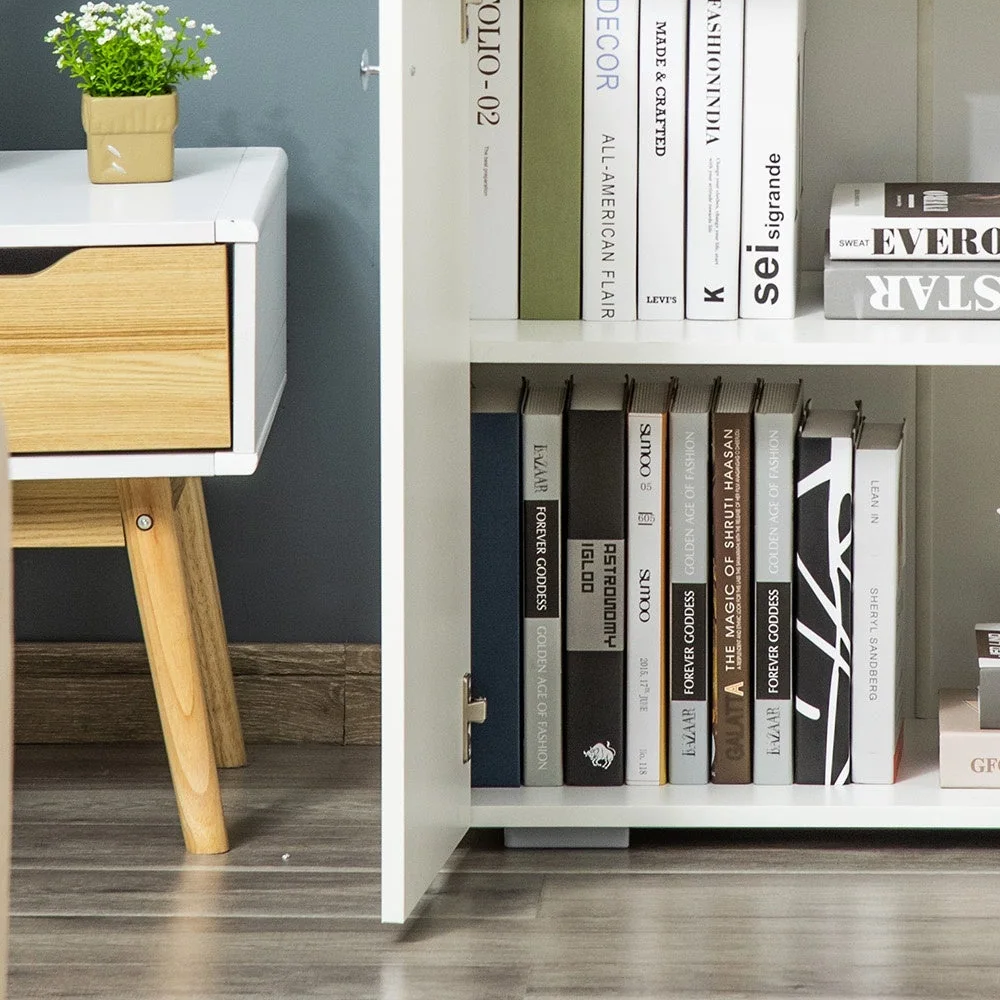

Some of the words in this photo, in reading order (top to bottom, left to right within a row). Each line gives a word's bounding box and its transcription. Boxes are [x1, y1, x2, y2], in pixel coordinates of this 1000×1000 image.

[656, 22, 667, 67] MADE
[656, 72, 666, 82] &
[654, 86, 667, 157] CRAFTED
[601, 134, 615, 262] ALL-AMERICAN
[764, 153, 785, 240] sigrande
[600, 271, 615, 320] FLAIR
[704, 287, 725, 302] K
[745, 244, 779, 306] sei
[646, 295, 677, 304] LEVI'S
[684, 431, 695, 480] FASHION
[723, 429, 734, 490] HAASAN
[768, 429, 779, 479] FASHION
[640, 482, 652, 491] 05
[684, 483, 695, 499] OF
[768, 482, 779, 498] OF
[871, 480, 879, 508] LEAN
[536, 506, 546, 555] FOREVER
[684, 502, 695, 525] AGE
[724, 498, 734, 549] SHRUTI
[768, 501, 779, 524] AGE
[871, 513, 879, 524] IN
[581, 543, 594, 593] IGLOO
[684, 528, 695, 576] GOLDEN
[724, 556, 734, 576] OF
[768, 527, 779, 575] GOLDEN
[536, 558, 547, 611] GODDESS
[684, 590, 694, 642] GODDESS
[725, 584, 735, 638] MAGIC
[768, 588, 779, 642] GODDESS
[869, 587, 878, 633] SHERYL
[537, 626, 546, 673] GOLDEN
[684, 645, 694, 694] FOREVER
[725, 646, 735, 671] THE
[768, 643, 778, 694] FOREVER
[869, 637, 878, 701] SANDBERG
[537, 677, 546, 698] AGE
[537, 702, 546, 718] OF
[537, 721, 548, 770] FASHION
